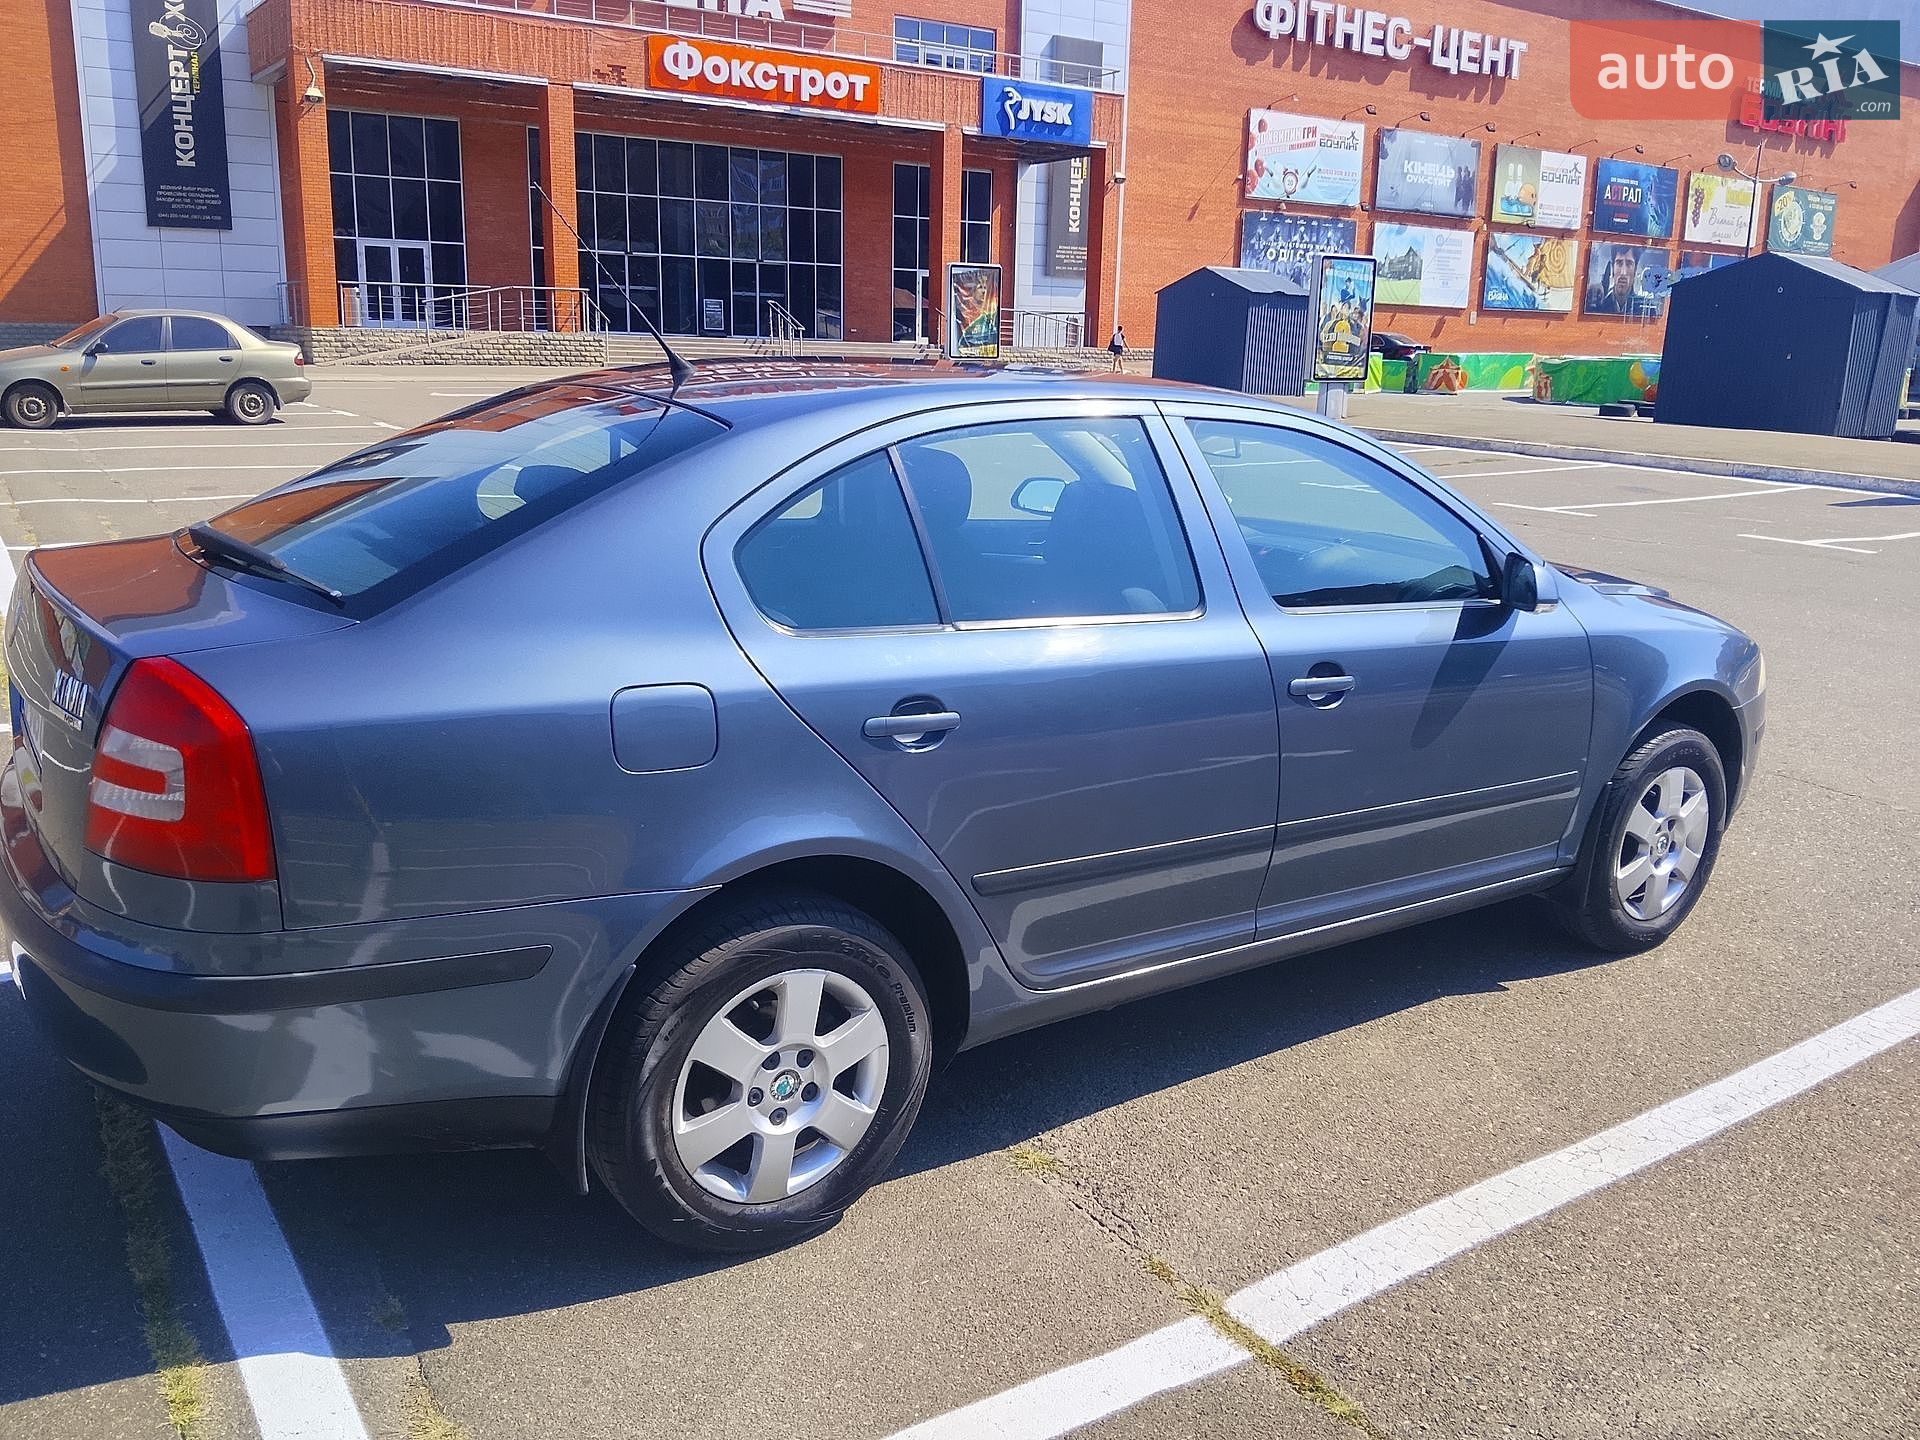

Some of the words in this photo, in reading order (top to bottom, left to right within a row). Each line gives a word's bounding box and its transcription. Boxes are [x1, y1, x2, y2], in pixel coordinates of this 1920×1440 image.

[663, 41, 870, 101] Фокстрот
[167, 44, 196, 168] КОНЦЕРТ
[1017, 98, 1073, 126] JYSK
[1319, 138, 1359, 151] БОУЛІНГ
[1403, 160, 1455, 179] КІНЕЦЬ
[1604, 184, 1642, 203] АСТРАЛ
